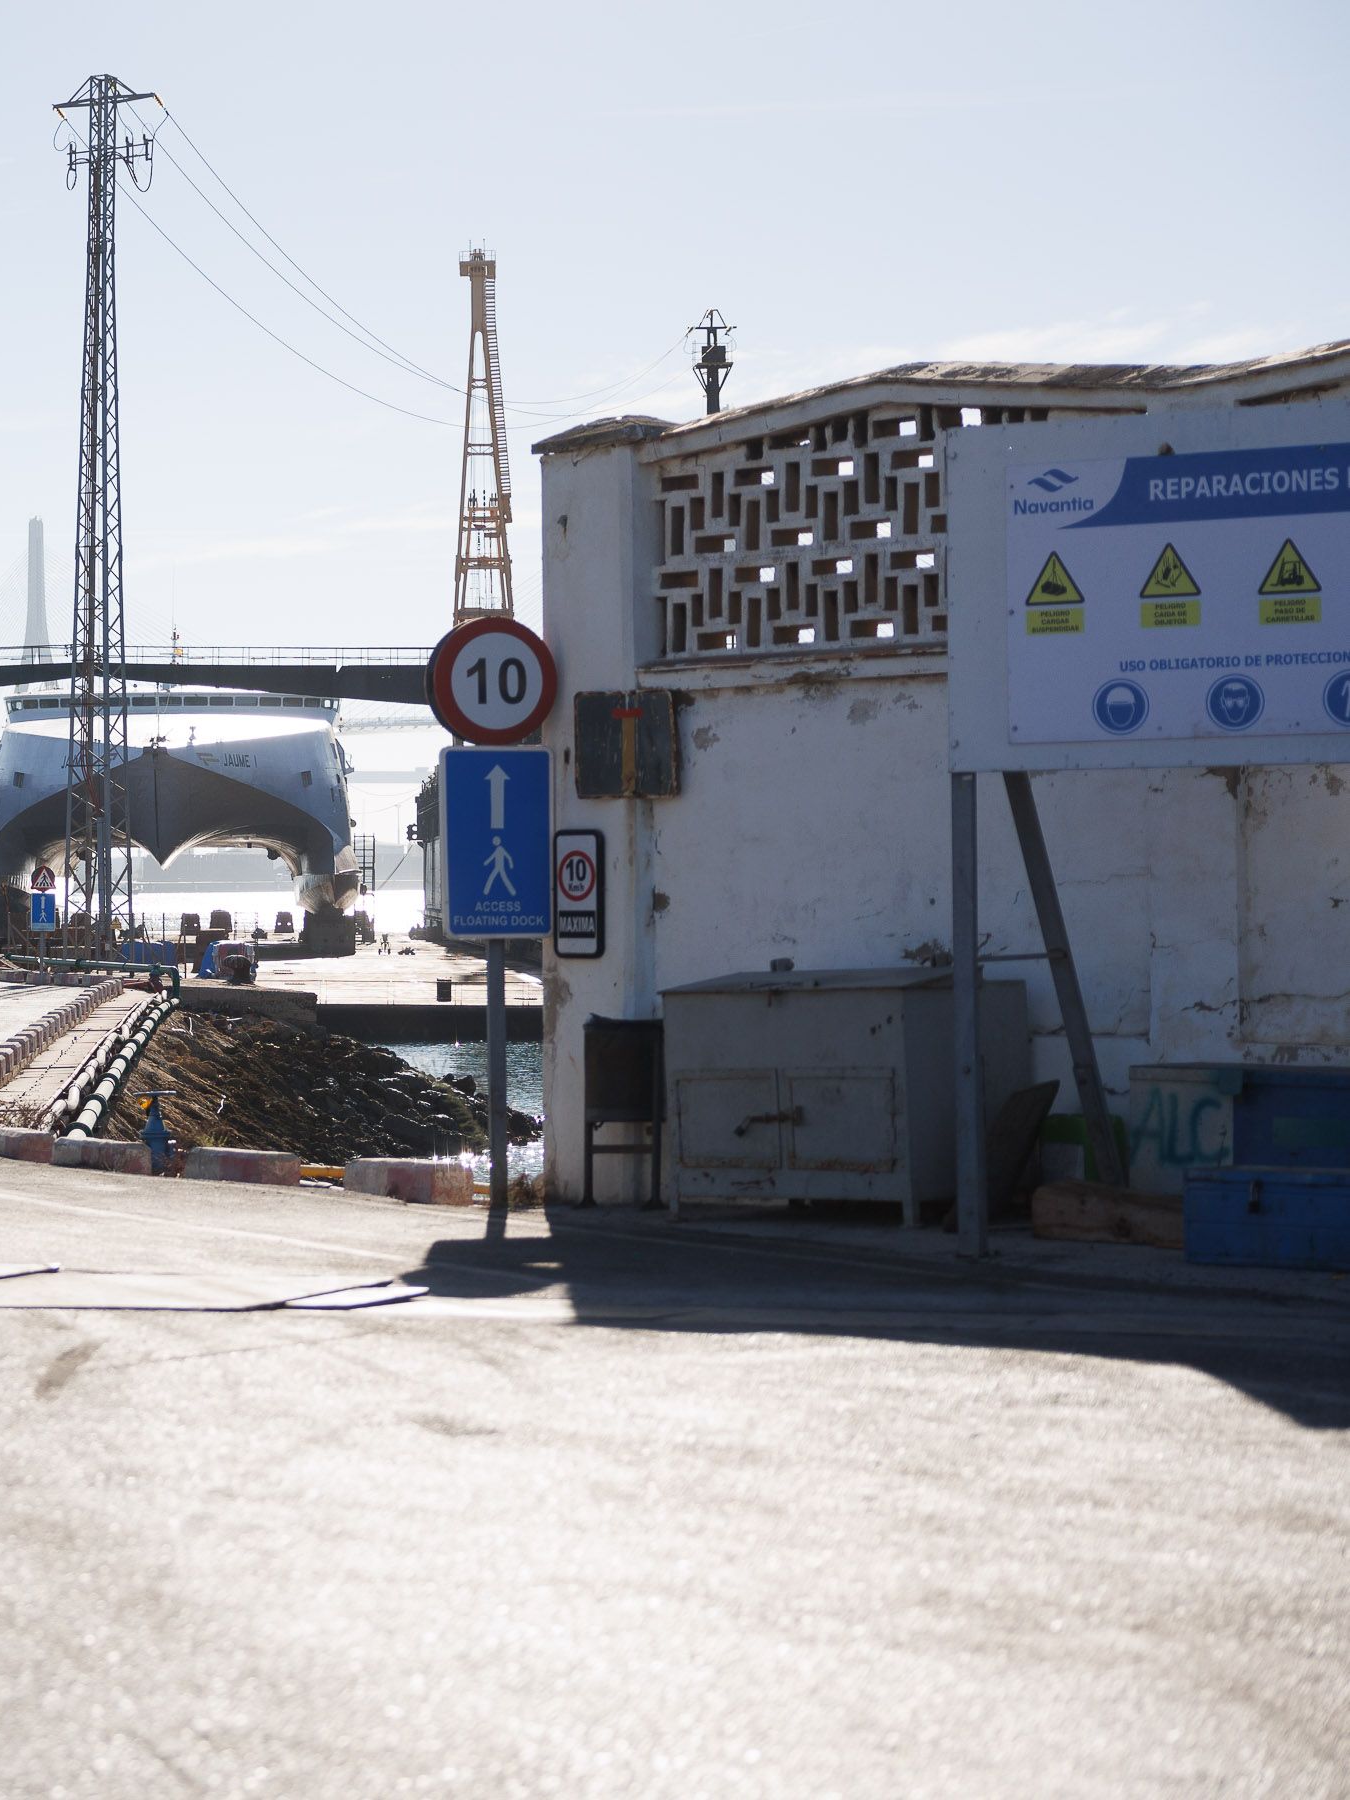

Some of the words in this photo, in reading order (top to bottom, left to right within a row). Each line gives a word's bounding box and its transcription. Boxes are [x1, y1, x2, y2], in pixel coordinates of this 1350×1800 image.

[1150, 467, 1340, 501] REPARACIONES
[1014, 494, 1094, 515] Navantia
[1120, 659, 1146, 672] USO
[1150, 656, 1241, 671] OBLIGATORIO
[1245, 655, 1262, 667] DE
[466, 657, 528, 705] 10
[223, 753, 251, 768] JAUME
[566, 858, 587, 881] 10
[474, 901, 521, 912] ACCESS
[453, 914, 508, 927] FLOATING
[511, 914, 545, 926] DOCK
[559, 916, 595, 932] MAXIMA
